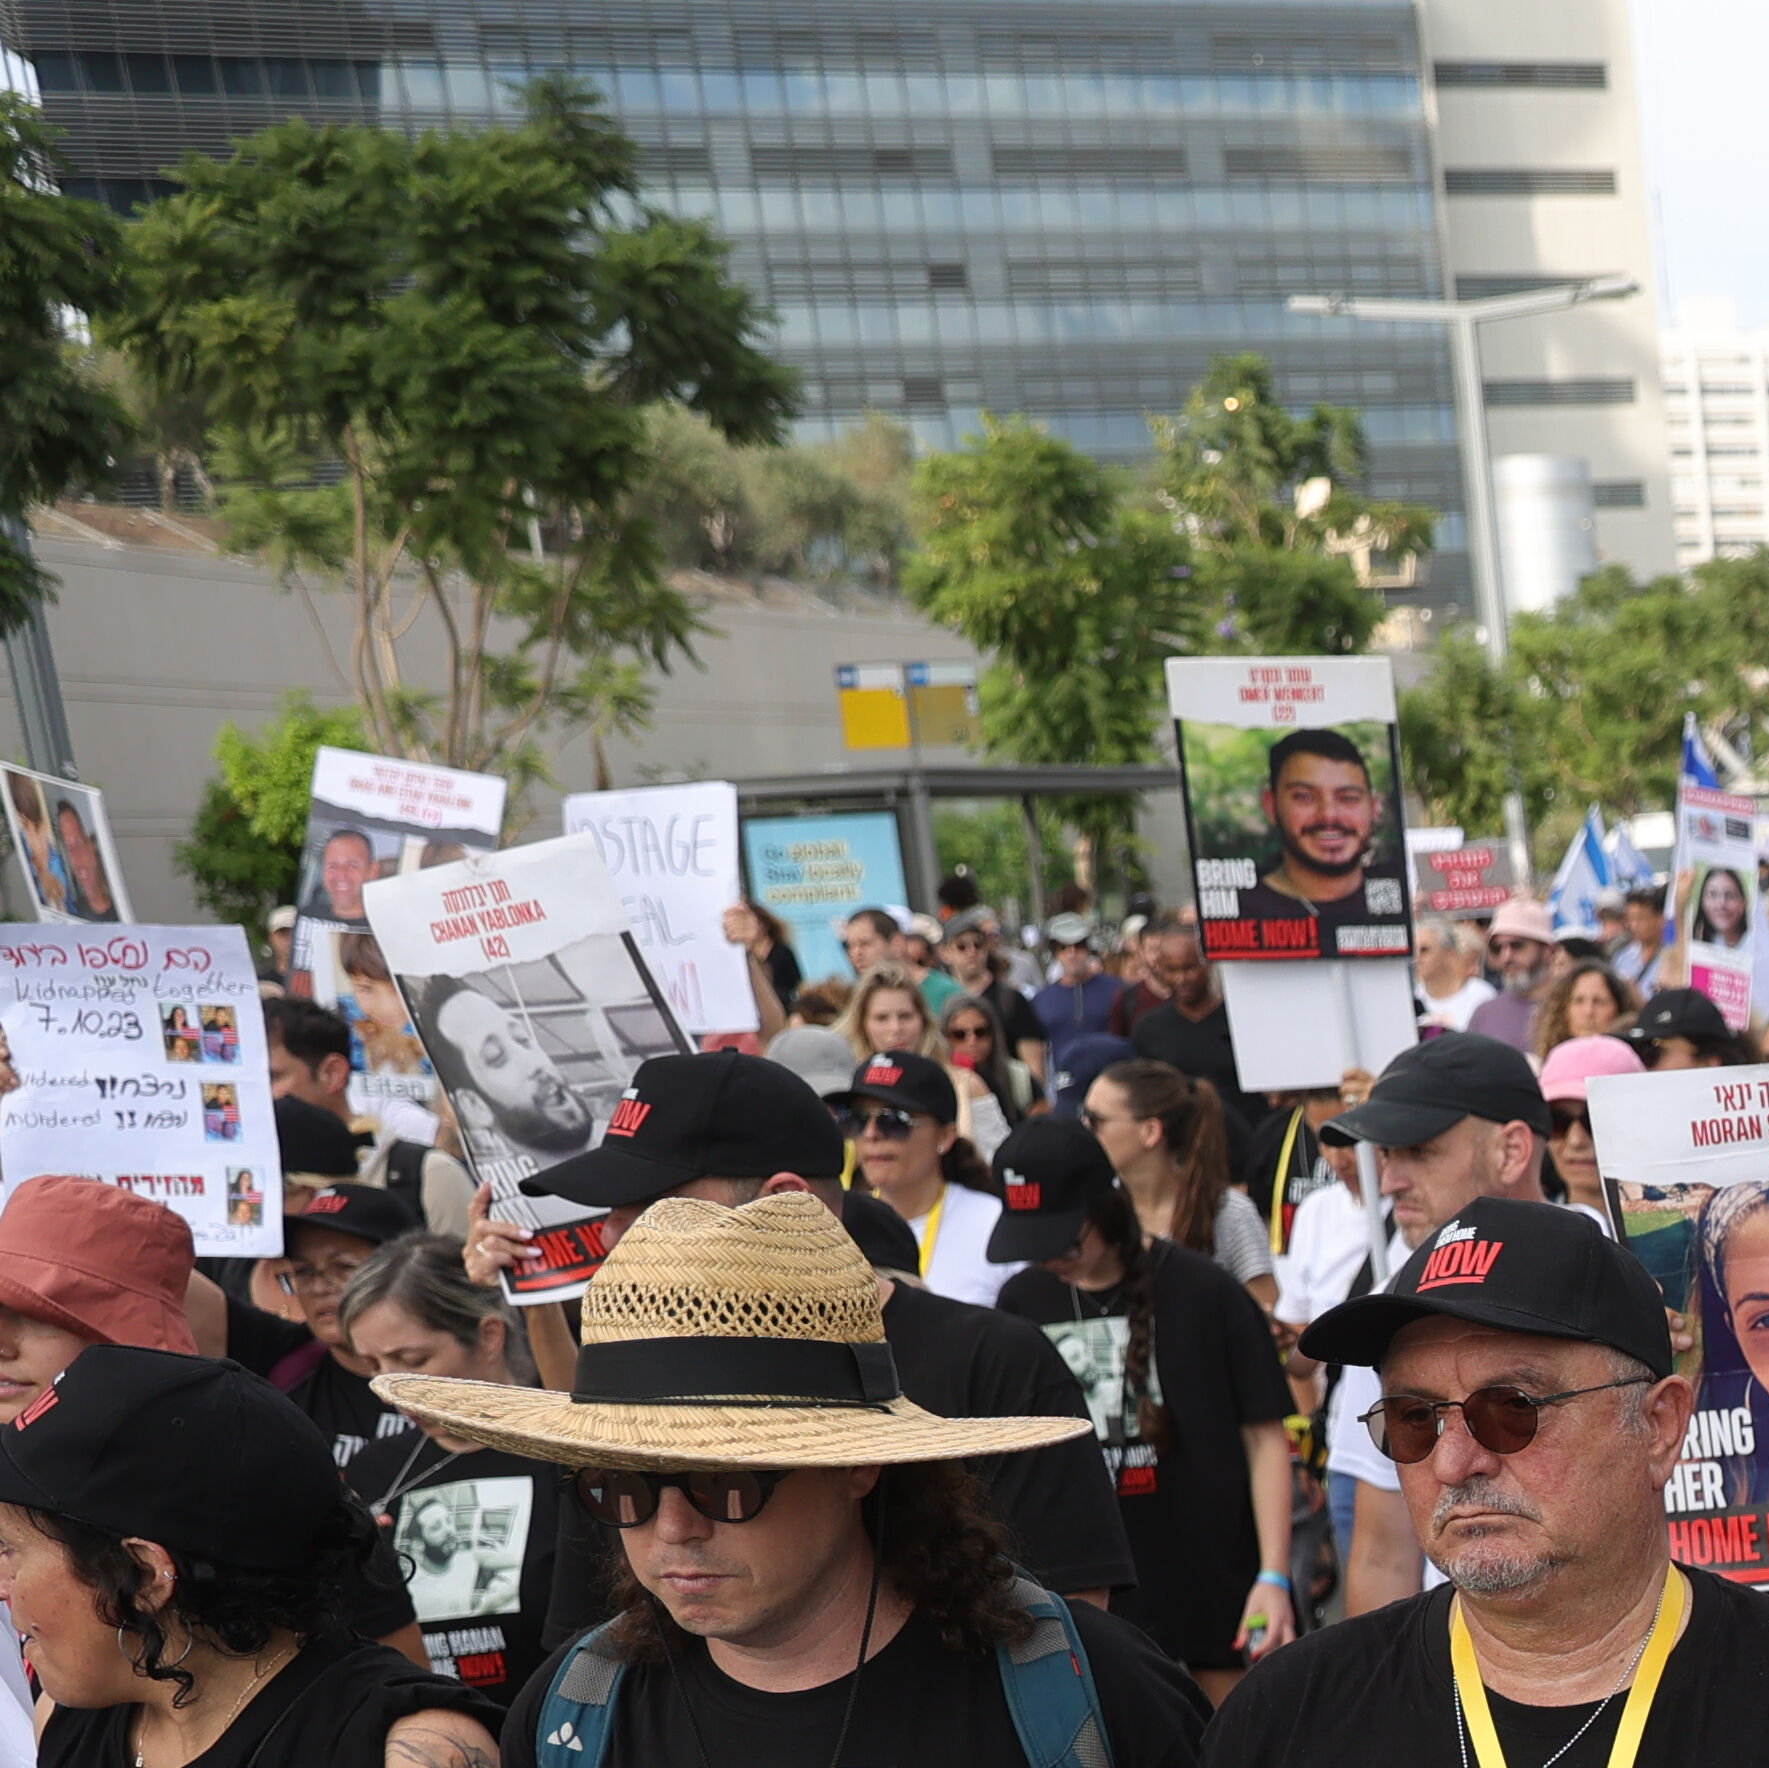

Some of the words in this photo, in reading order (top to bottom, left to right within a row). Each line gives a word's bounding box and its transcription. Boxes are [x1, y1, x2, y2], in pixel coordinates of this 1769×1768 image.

[1196, 858, 1258, 890] BRING
[429, 914, 480, 944] CHANAN
[477, 898, 547, 932] YABLONKA
[1199, 888, 1240, 919] HIM
[480, 934, 511, 962] (42)
[1203, 919, 1260, 949] HOME
[1261, 915, 1321, 950] NOW!
[163, 946, 213, 973] הם
[28, 1001, 144, 1042] 7.10.23
[611, 1098, 652, 1131] OW
[1713, 1084, 1752, 1112] ינאי
[1690, 1112, 1762, 1147] MORAN
[478, 1153, 541, 1203] RING
[513, 1227, 586, 1277] OME
[1419, 1239, 1503, 1285] NOW
[1680, 1406, 1756, 1460] RING
[1664, 1460, 1727, 1514] HER
[1668, 1513, 1762, 1567] HOME
